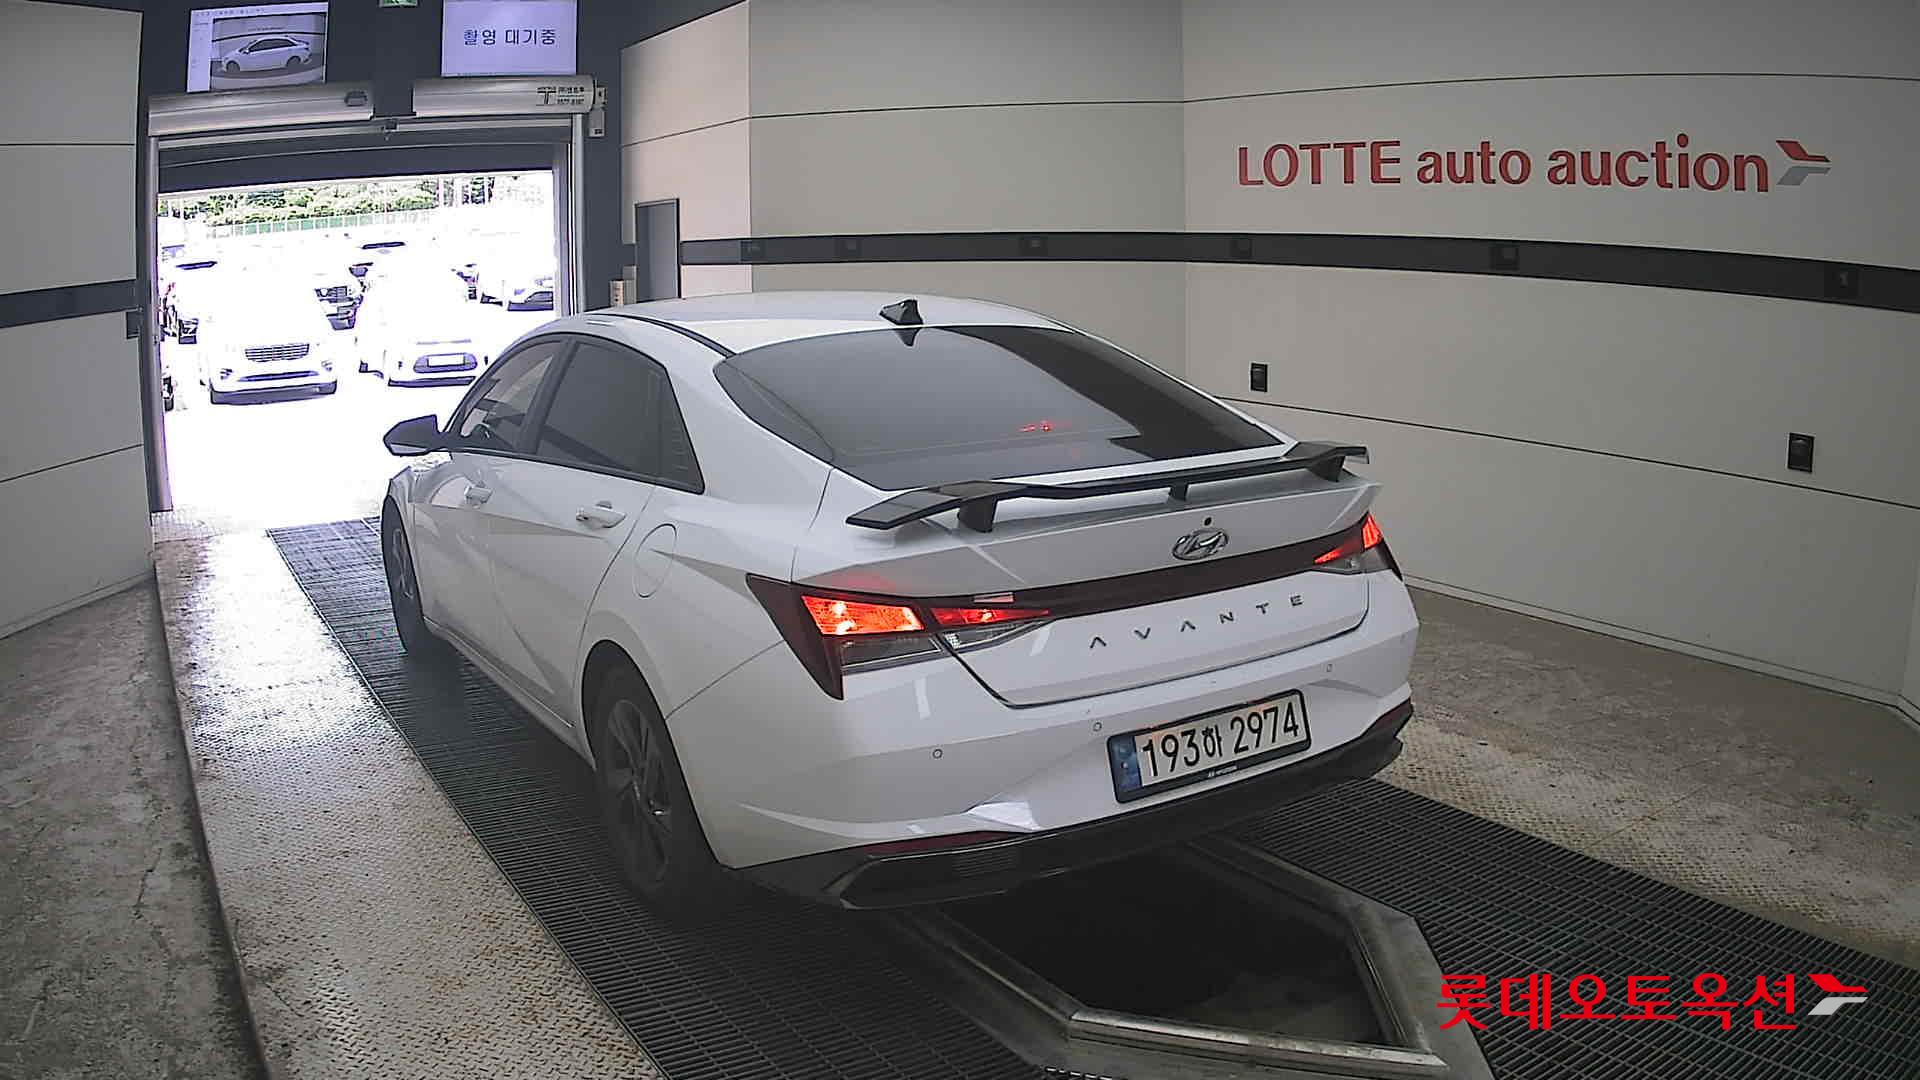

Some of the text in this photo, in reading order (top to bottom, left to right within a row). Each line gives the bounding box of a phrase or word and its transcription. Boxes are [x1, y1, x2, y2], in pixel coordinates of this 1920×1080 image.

[464, 29, 557, 46] 촬영 대기중
[1238, 133, 1770, 193] LOTTE auto auction
[1089, 594, 1304, 649] AVANTE
[1142, 701, 1300, 777] 193하 2974
